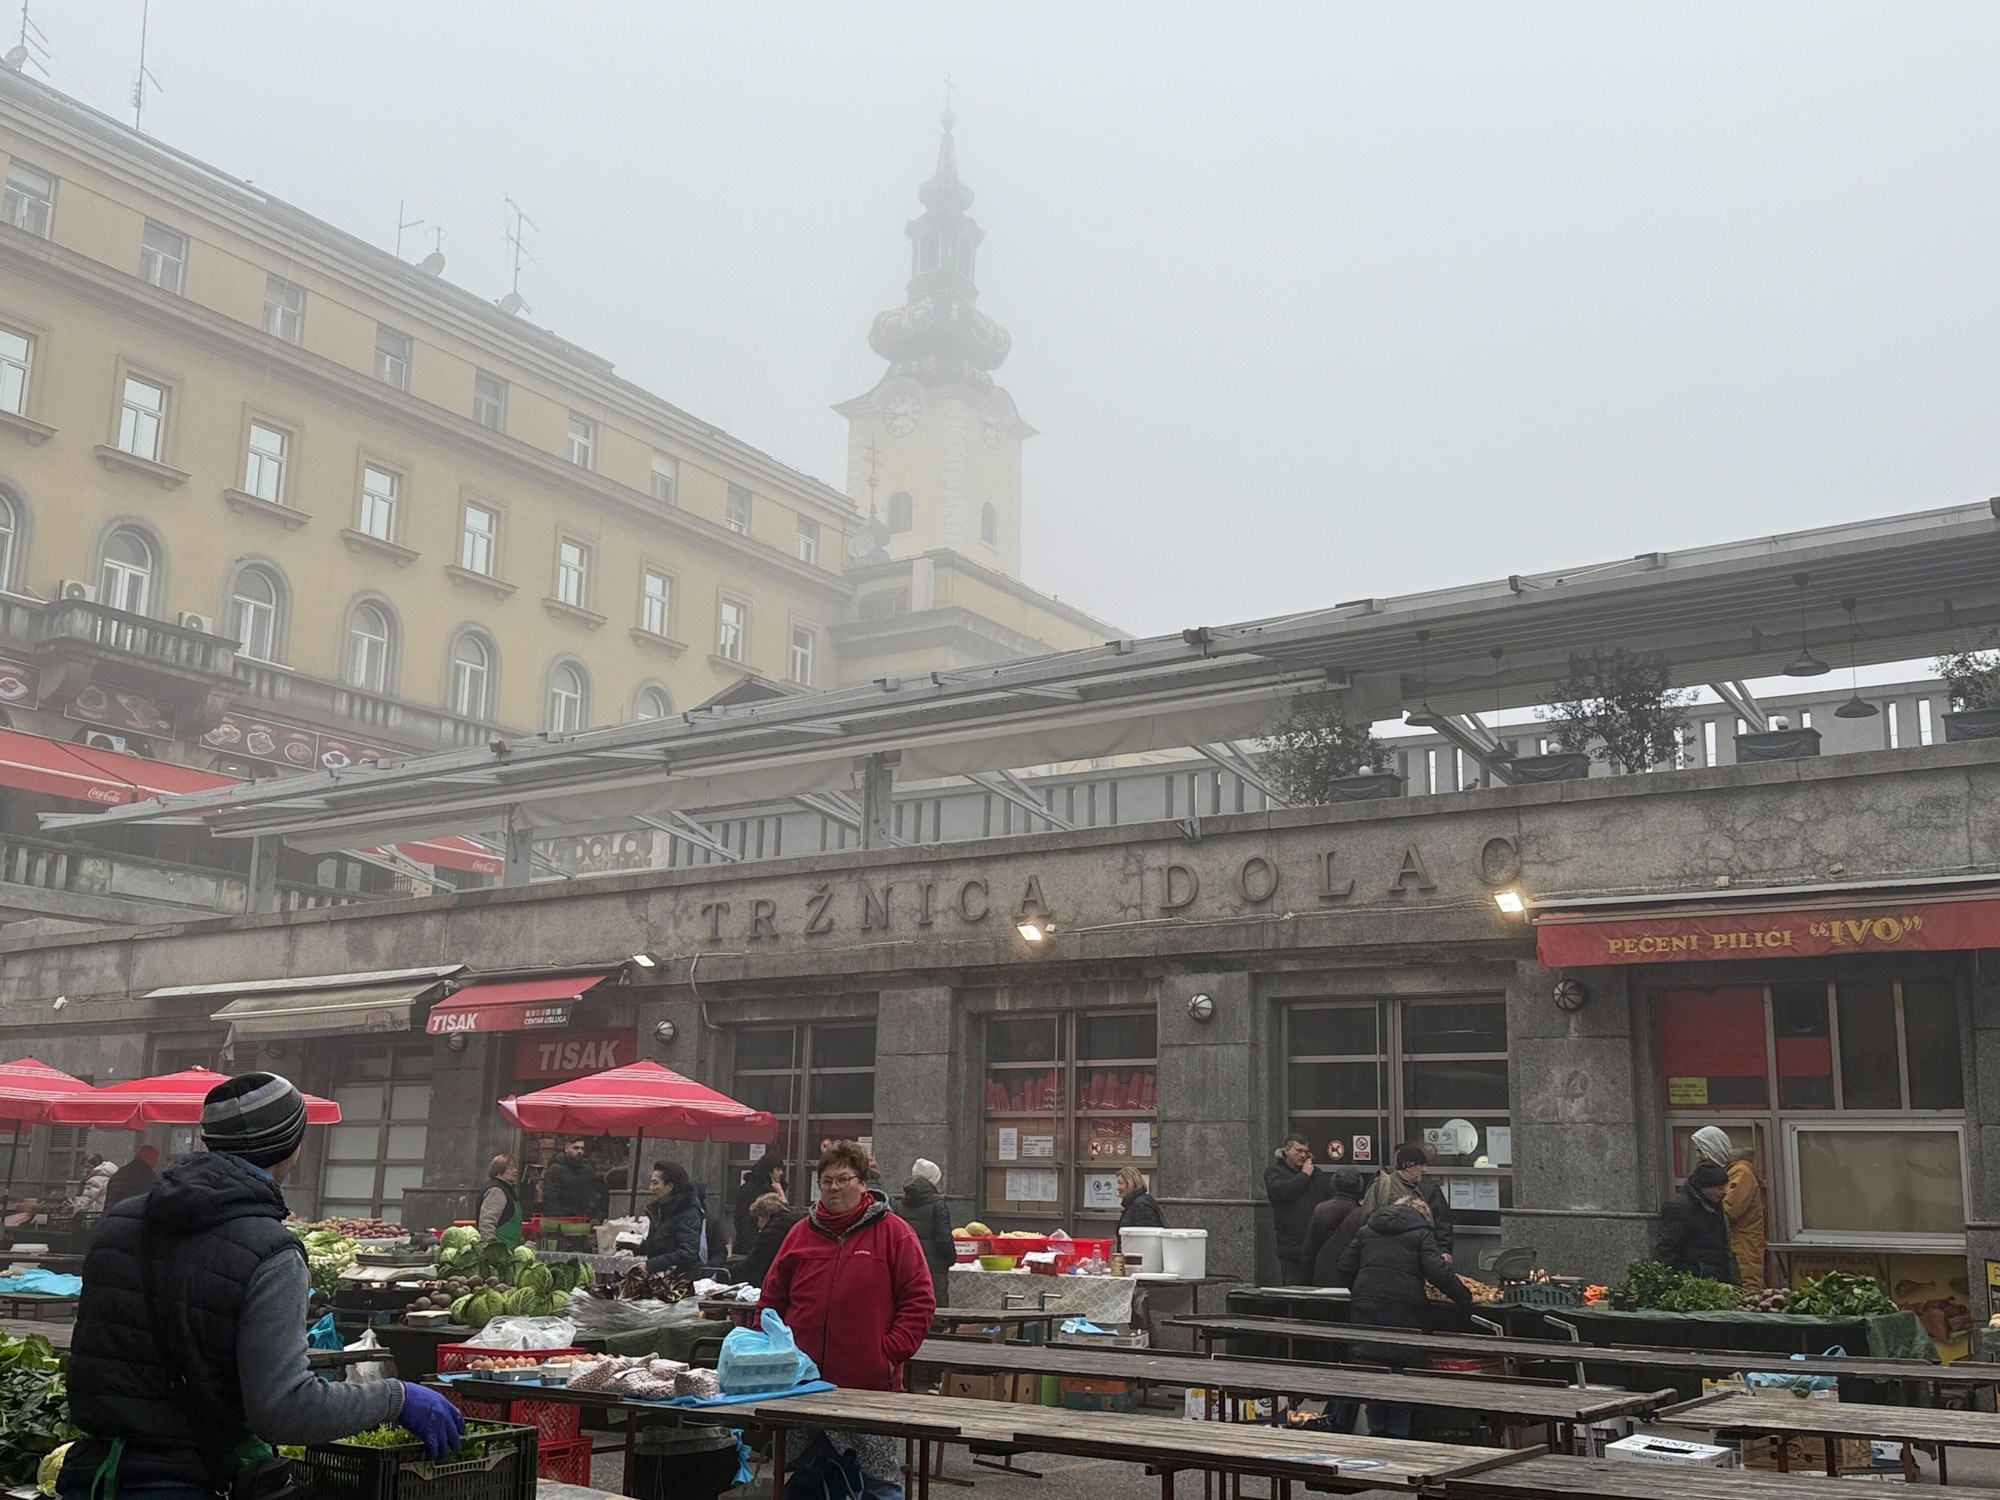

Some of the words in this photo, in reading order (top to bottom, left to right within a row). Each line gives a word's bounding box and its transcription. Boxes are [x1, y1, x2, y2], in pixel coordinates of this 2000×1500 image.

[701, 874, 1053, 942] TRŽNICA
[1159, 835, 1521, 909] DOLAC
[1607, 932, 1698, 954] PEČENI
[1712, 926, 1793, 949] PILIĆI
[432, 1012, 479, 1032] TISAK
[524, 1016, 544, 1026] CENTAR
[544, 1014, 567, 1024] USLUGA
[539, 1040, 620, 1071] TISAK
[1631, 1452, 1658, 1461] PREMIUM
[1658, 1455, 1674, 1463] PACK
